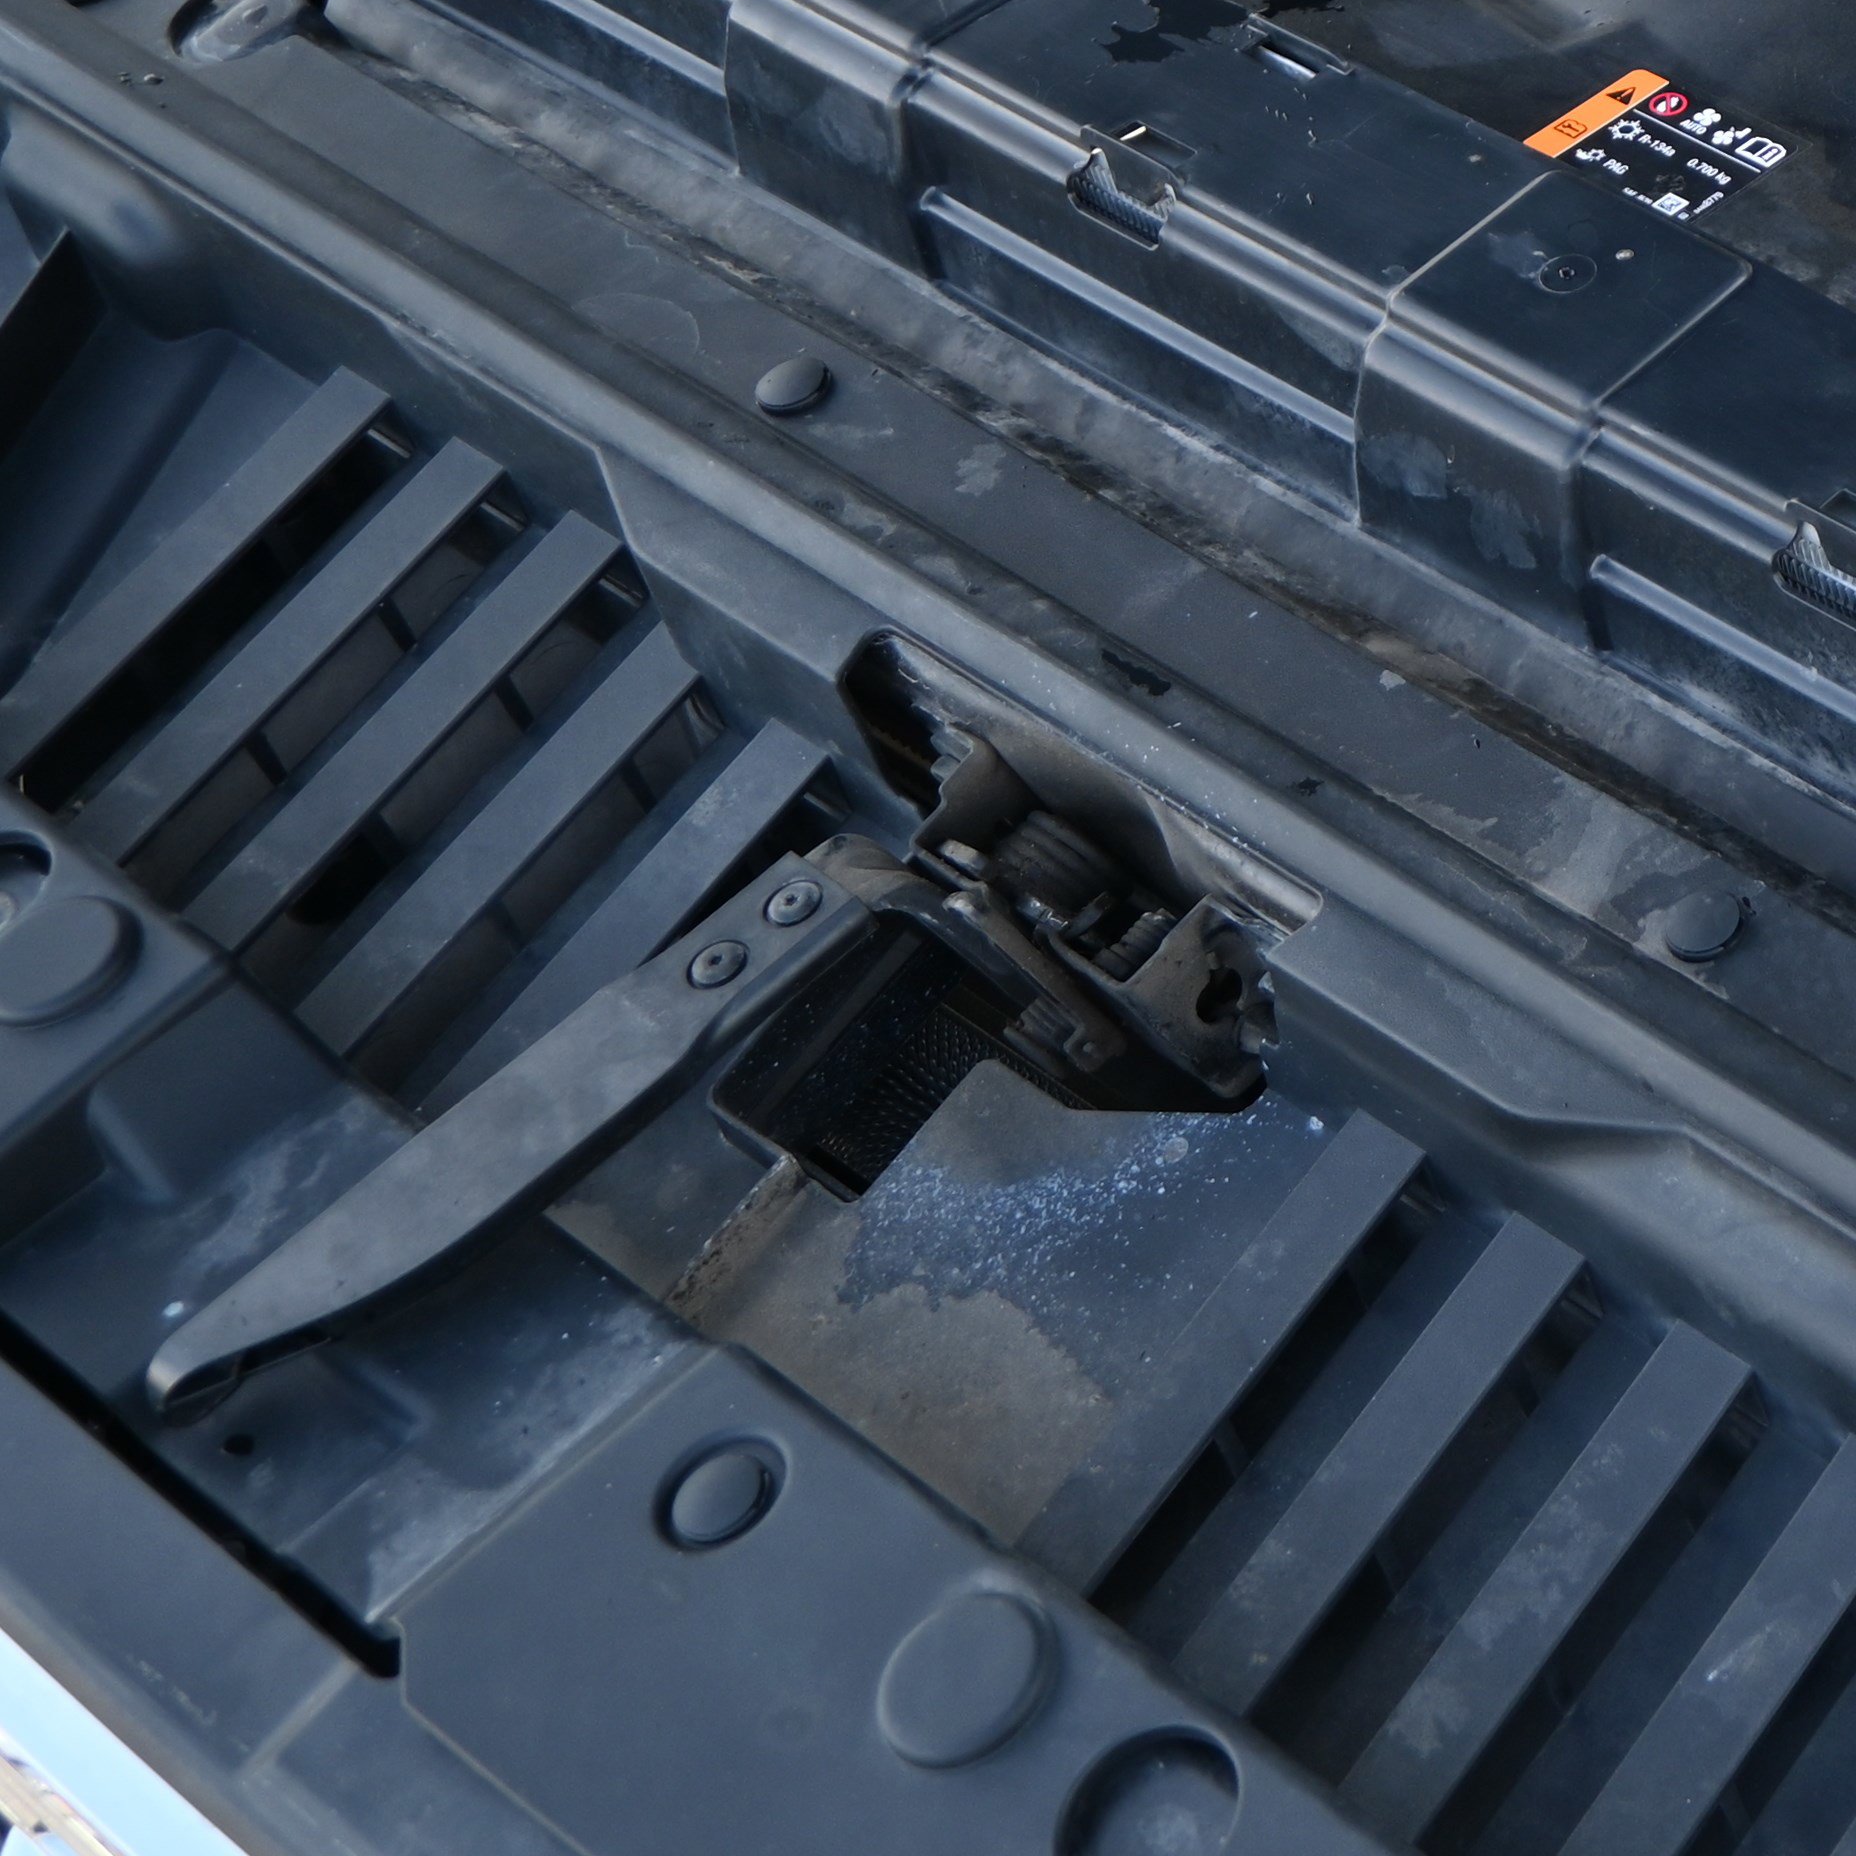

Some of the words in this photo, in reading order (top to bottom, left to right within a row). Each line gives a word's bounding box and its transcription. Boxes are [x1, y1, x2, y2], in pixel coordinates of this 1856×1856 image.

[1679, 119, 1707, 135] AUTO
[1638, 134, 1676, 157] R-134a
[1603, 158, 1629, 175] PAG
[1686, 158, 1718, 177] 0.700
[1715, 171, 1732, 185] kg
